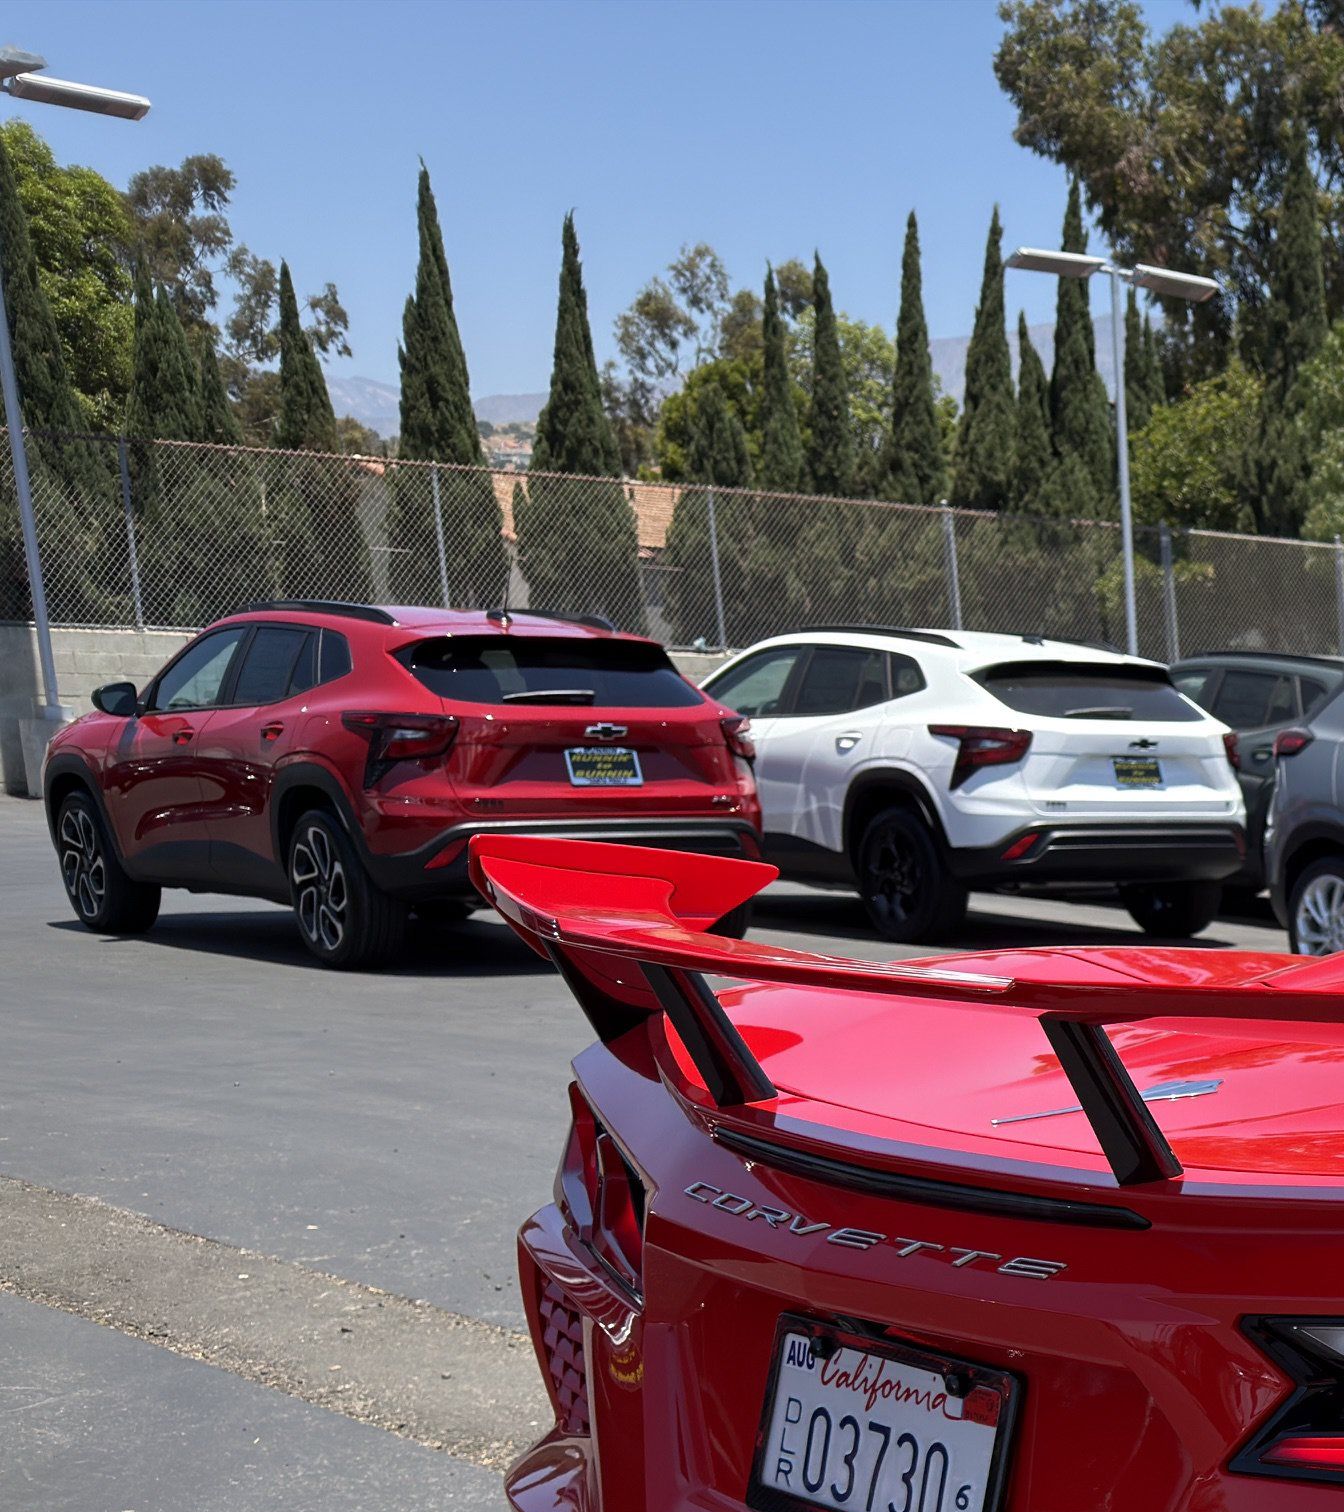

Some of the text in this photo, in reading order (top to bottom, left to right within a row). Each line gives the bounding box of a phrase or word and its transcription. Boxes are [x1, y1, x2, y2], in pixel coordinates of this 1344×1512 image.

[684, 1181, 1069, 1280] CORVETTE
[786, 1340, 815, 1368] AUG
[820, 1347, 966, 1420] California
[775, 1397, 801, 1488] DLR
